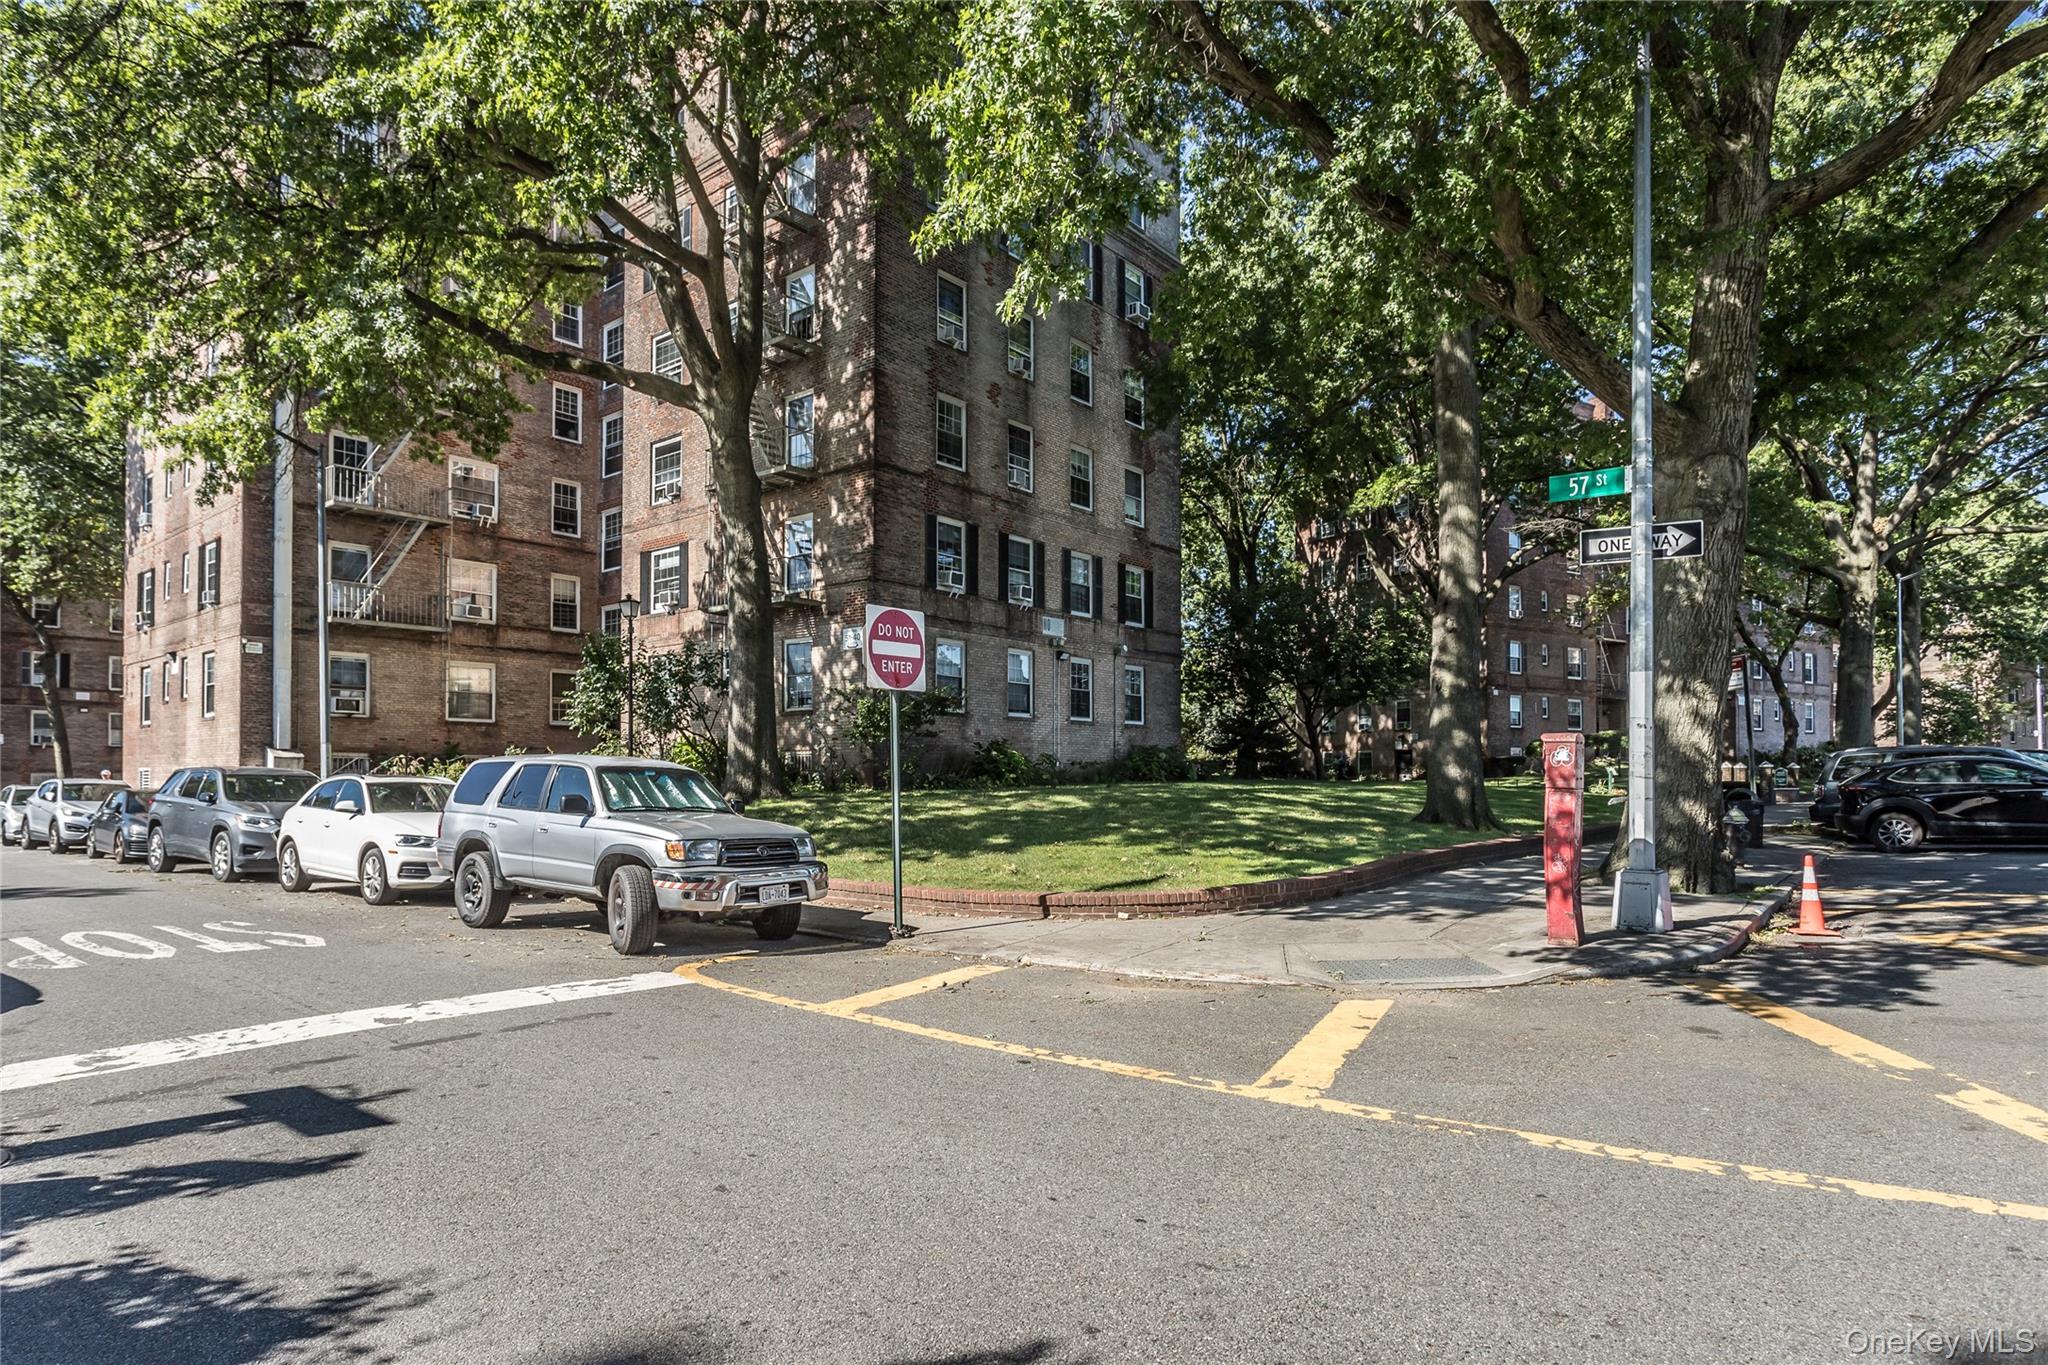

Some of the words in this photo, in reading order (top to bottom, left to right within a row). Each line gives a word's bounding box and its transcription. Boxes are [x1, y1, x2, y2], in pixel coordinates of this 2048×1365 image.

[1569, 475, 1589, 497] 57
[1598, 538, 1631, 553] ONE
[878, 623, 892, 637] DO
[895, 625, 914, 640] NOT
[881, 659, 913, 674] ENTER
[6, 920, 326, 969] STOP
